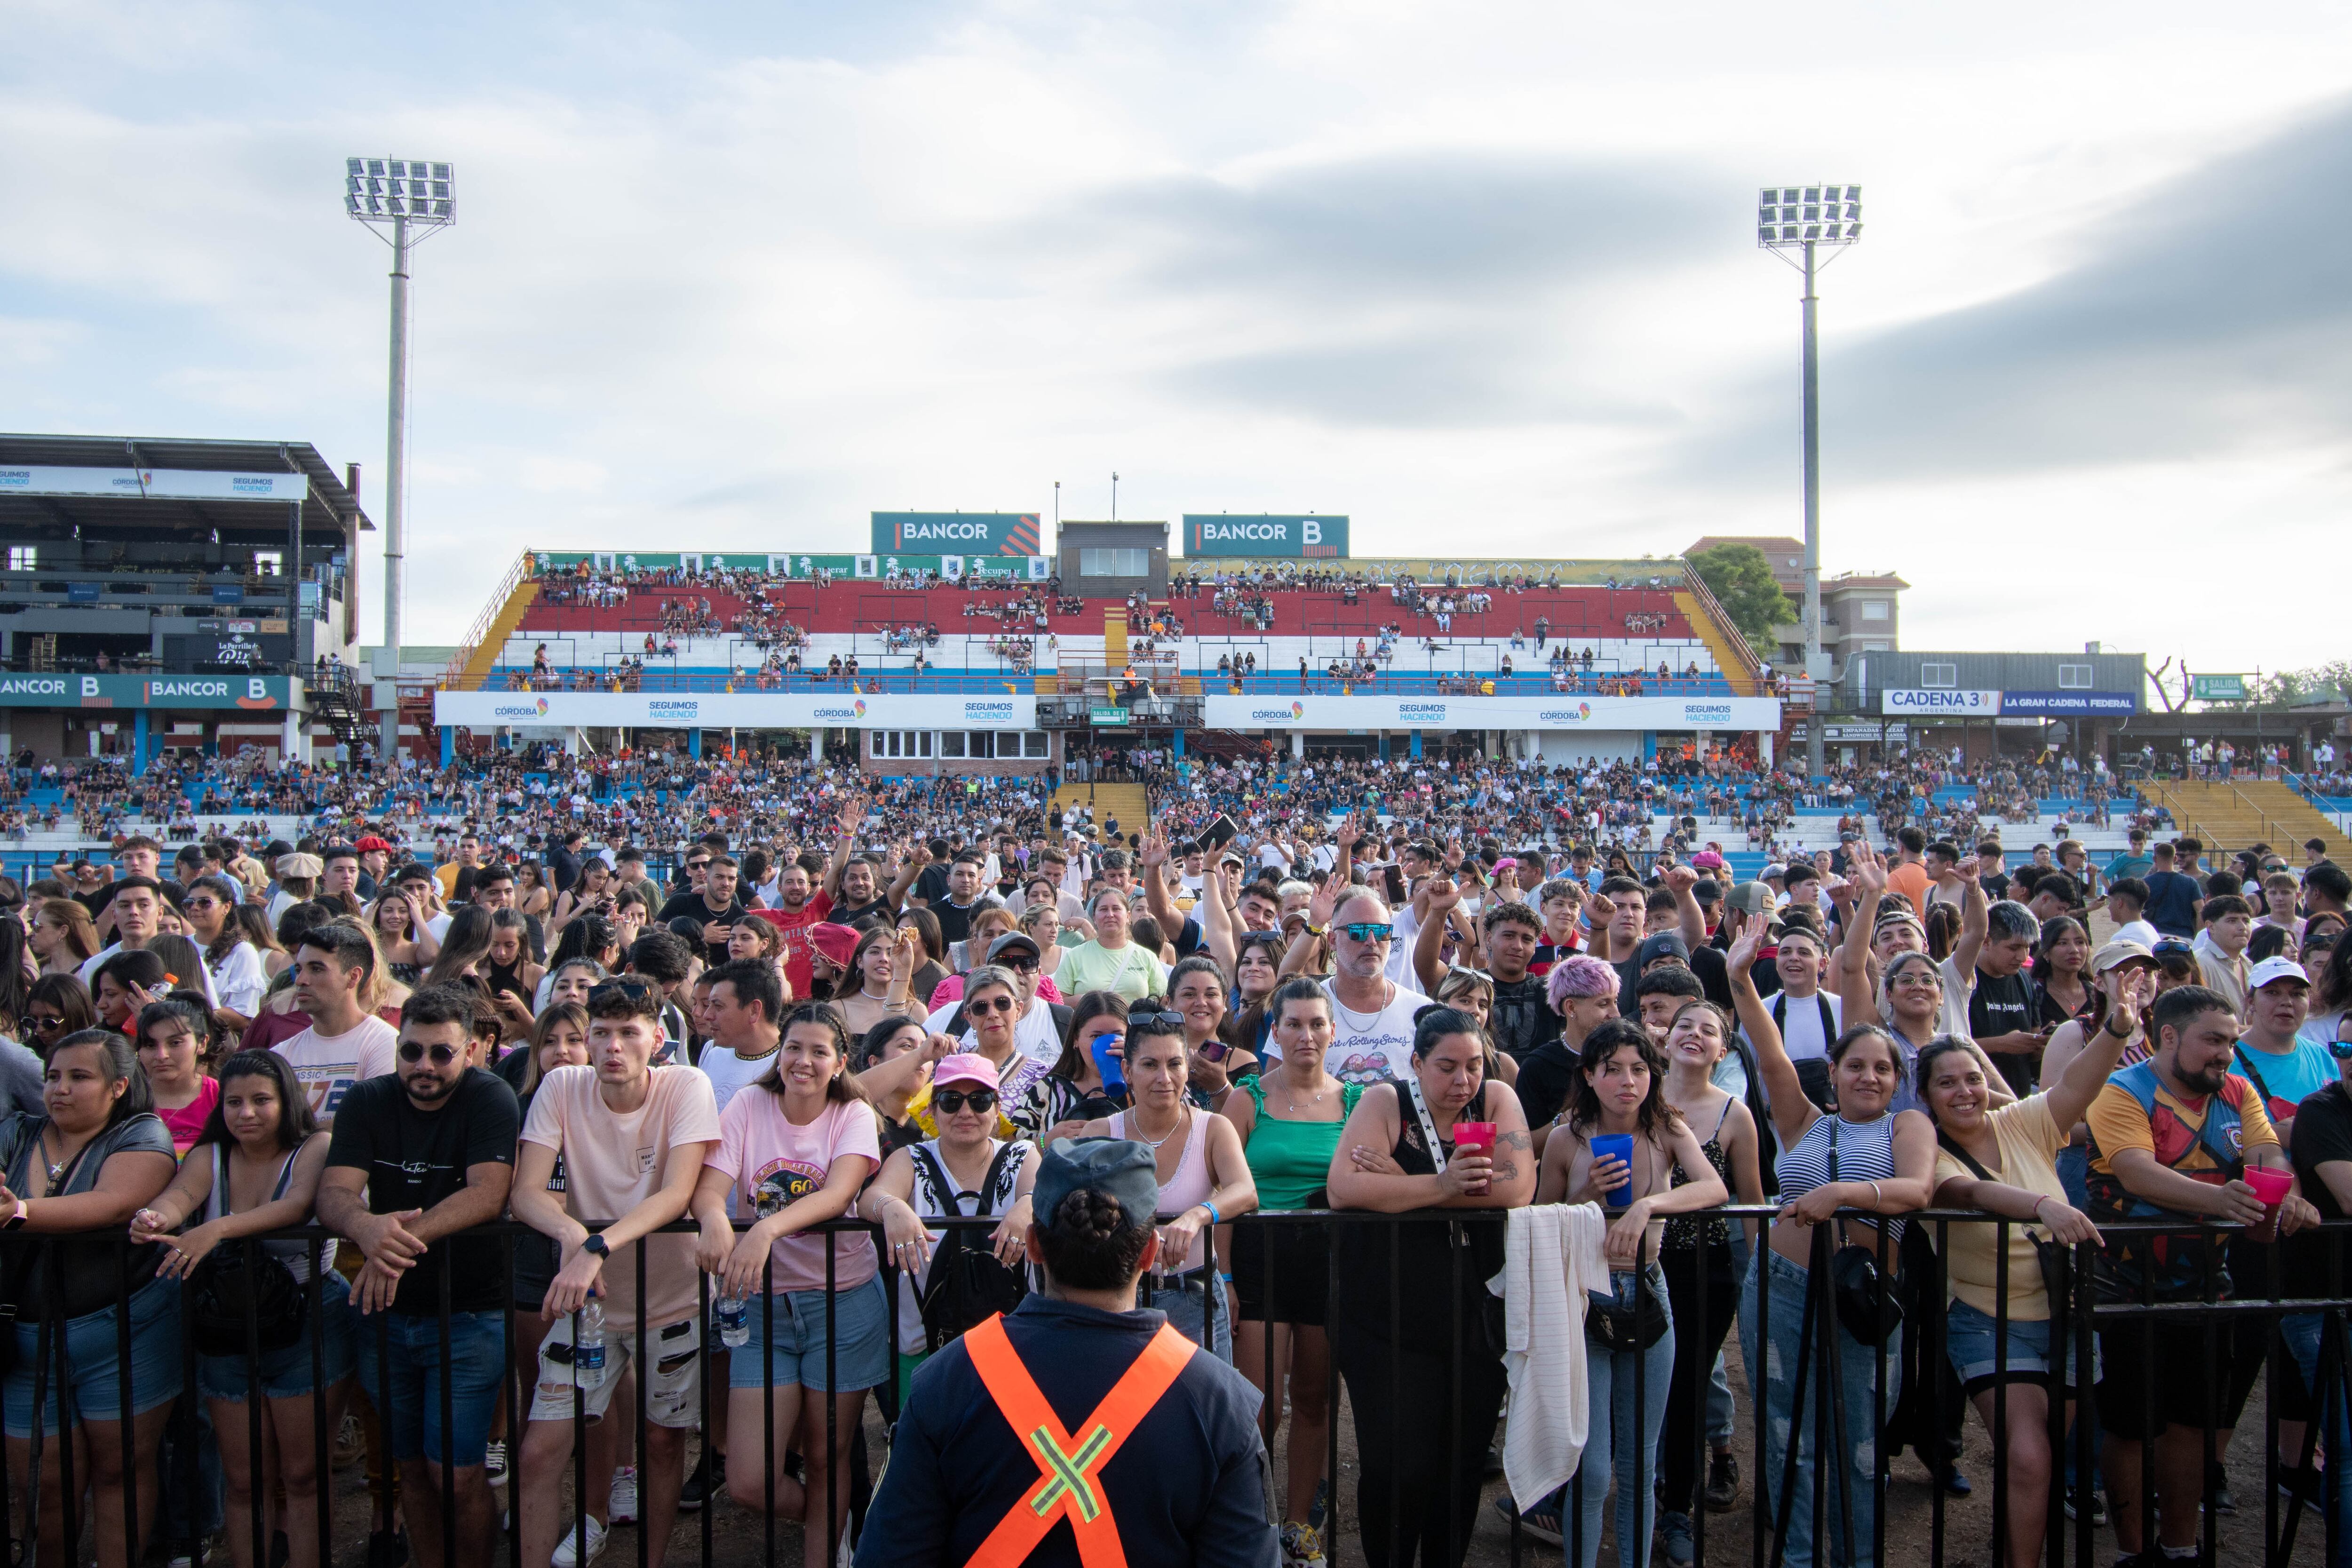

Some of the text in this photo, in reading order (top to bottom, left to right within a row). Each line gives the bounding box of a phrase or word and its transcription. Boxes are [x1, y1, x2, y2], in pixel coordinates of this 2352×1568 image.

[904, 523, 988, 540] BANCOR
[1204, 524, 1286, 540] BANCOR
[1303, 521, 1322, 544] B
[0, 677, 99, 697] ANCOR B
[152, 678, 266, 699] BANCOR B
[2209, 679, 2239, 689] SALIDA
[1892, 692, 1979, 707] CADENA 3
[2090, 700, 2132, 708] FEDERAL
[495, 706, 537, 715] CÓRDOBA
[814, 708, 855, 717] CÓRDOBA
[1252, 709, 1293, 718] CÓRDOBA
[1540, 711, 1580, 719] CÓRDOBA
[790, 946, 801, 955] 965
[2002, 1003, 2025, 1012] Angels
[1343, 1036, 1380, 1050] Rolling
[1380, 1034, 1410, 1047] Stones
[755, 1162, 779, 1185] BLACK
[790, 1179, 813, 1194] 60
